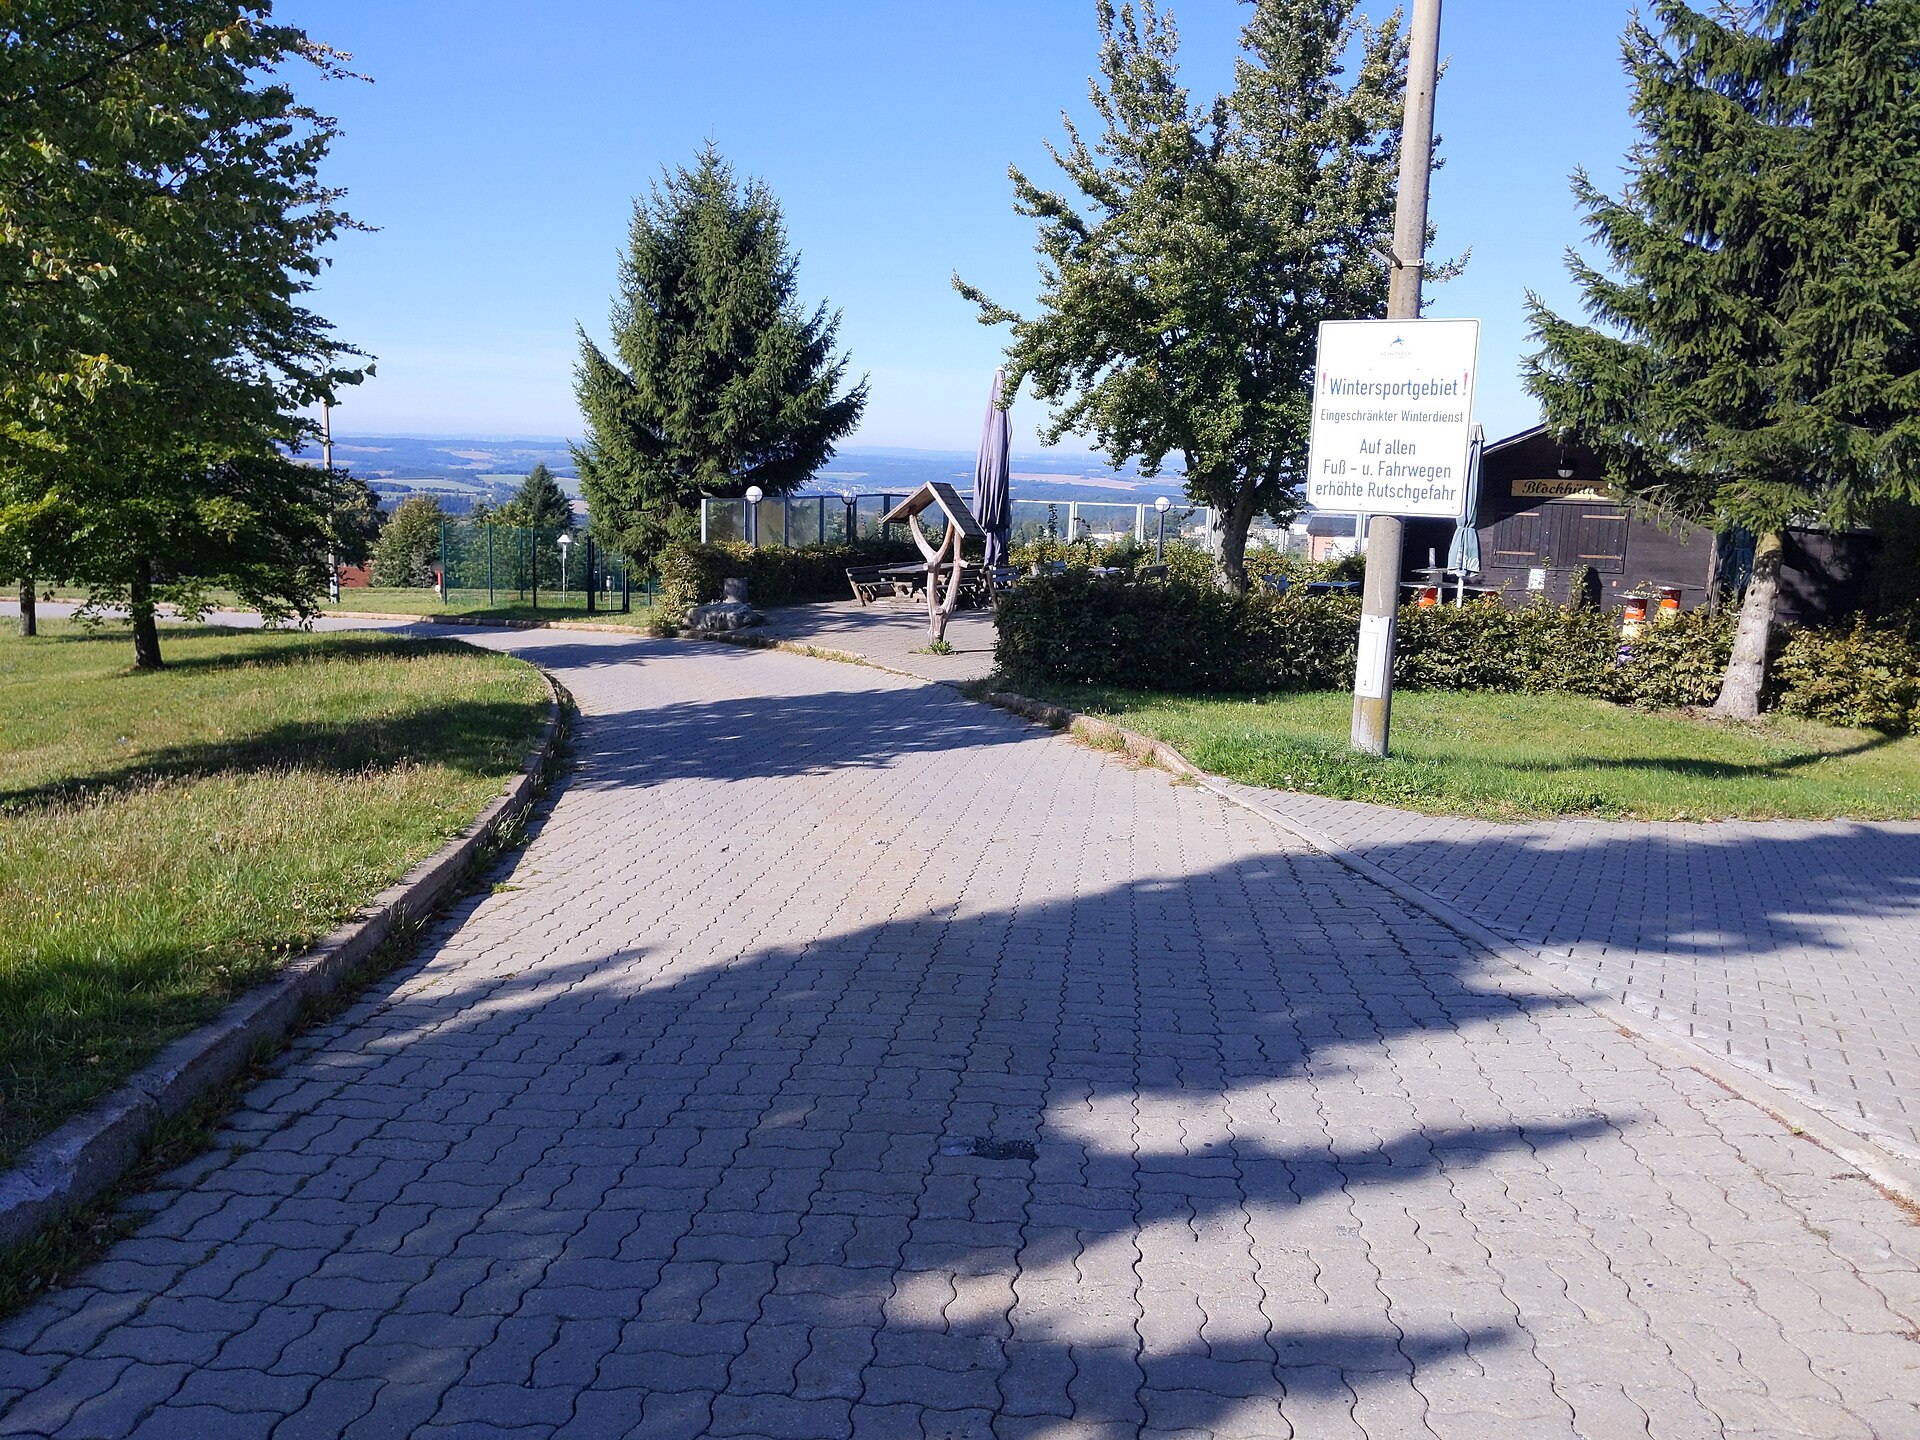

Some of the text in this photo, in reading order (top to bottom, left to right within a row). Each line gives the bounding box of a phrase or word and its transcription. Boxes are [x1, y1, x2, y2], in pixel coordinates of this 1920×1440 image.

[1330, 378, 1458, 400] Wintersportgebiet
[1321, 409, 1463, 423] Eingeschränkter Winterdienst
[1360, 439, 1416, 455] Auf allen
[1324, 459, 1346, 474] Fuß
[1362, 464, 1373, 475] u.
[1378, 461, 1451, 481] Fahrwegen
[1316, 481, 1456, 503] erhöhte Rutschgefahr
